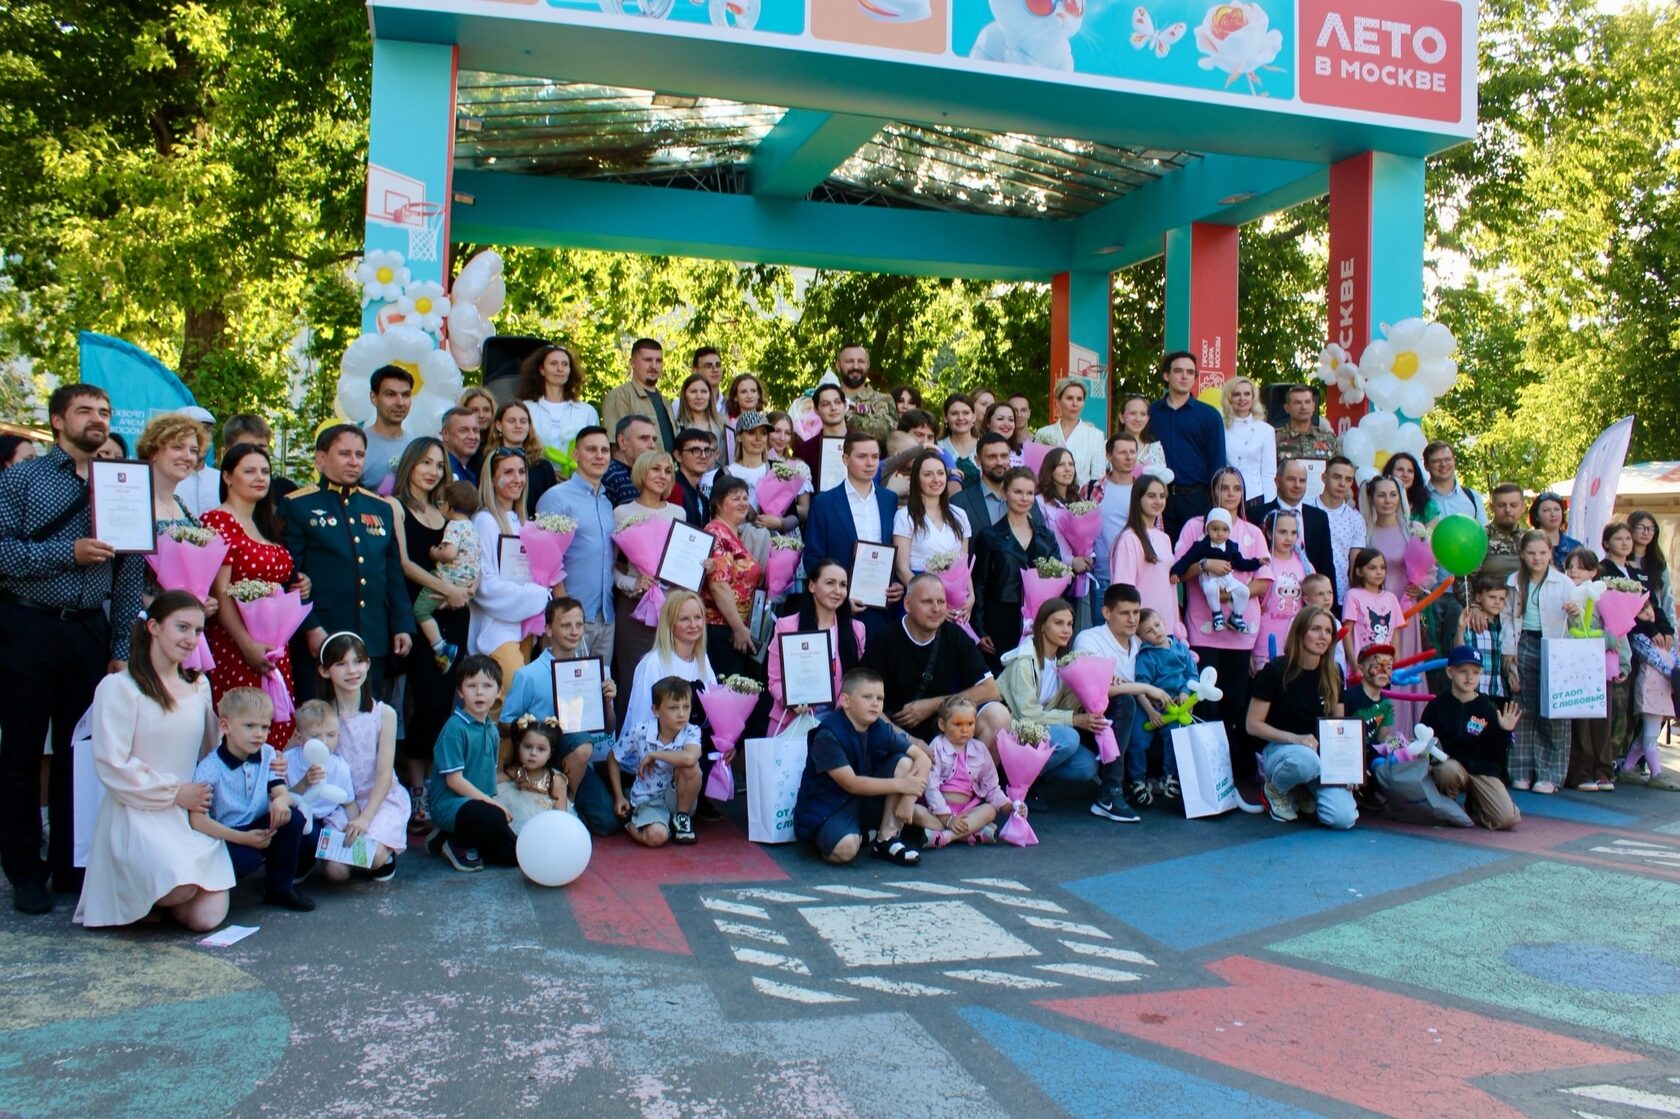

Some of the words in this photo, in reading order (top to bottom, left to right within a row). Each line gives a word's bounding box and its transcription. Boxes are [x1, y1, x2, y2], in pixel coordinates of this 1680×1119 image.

[1316, 12, 1447, 64] ЛЕТО
[1315, 56, 1331, 76] В
[1341, 59, 1446, 93] МОСКВЕ
[1339, 258, 1354, 365] СКВЕ
[1552, 691, 1564, 700] ОТ
[1559, 694, 1605, 708] ЛЮБОВЬЮ
[776, 808, 789, 818] ОТ
[776, 822, 783, 830] С
